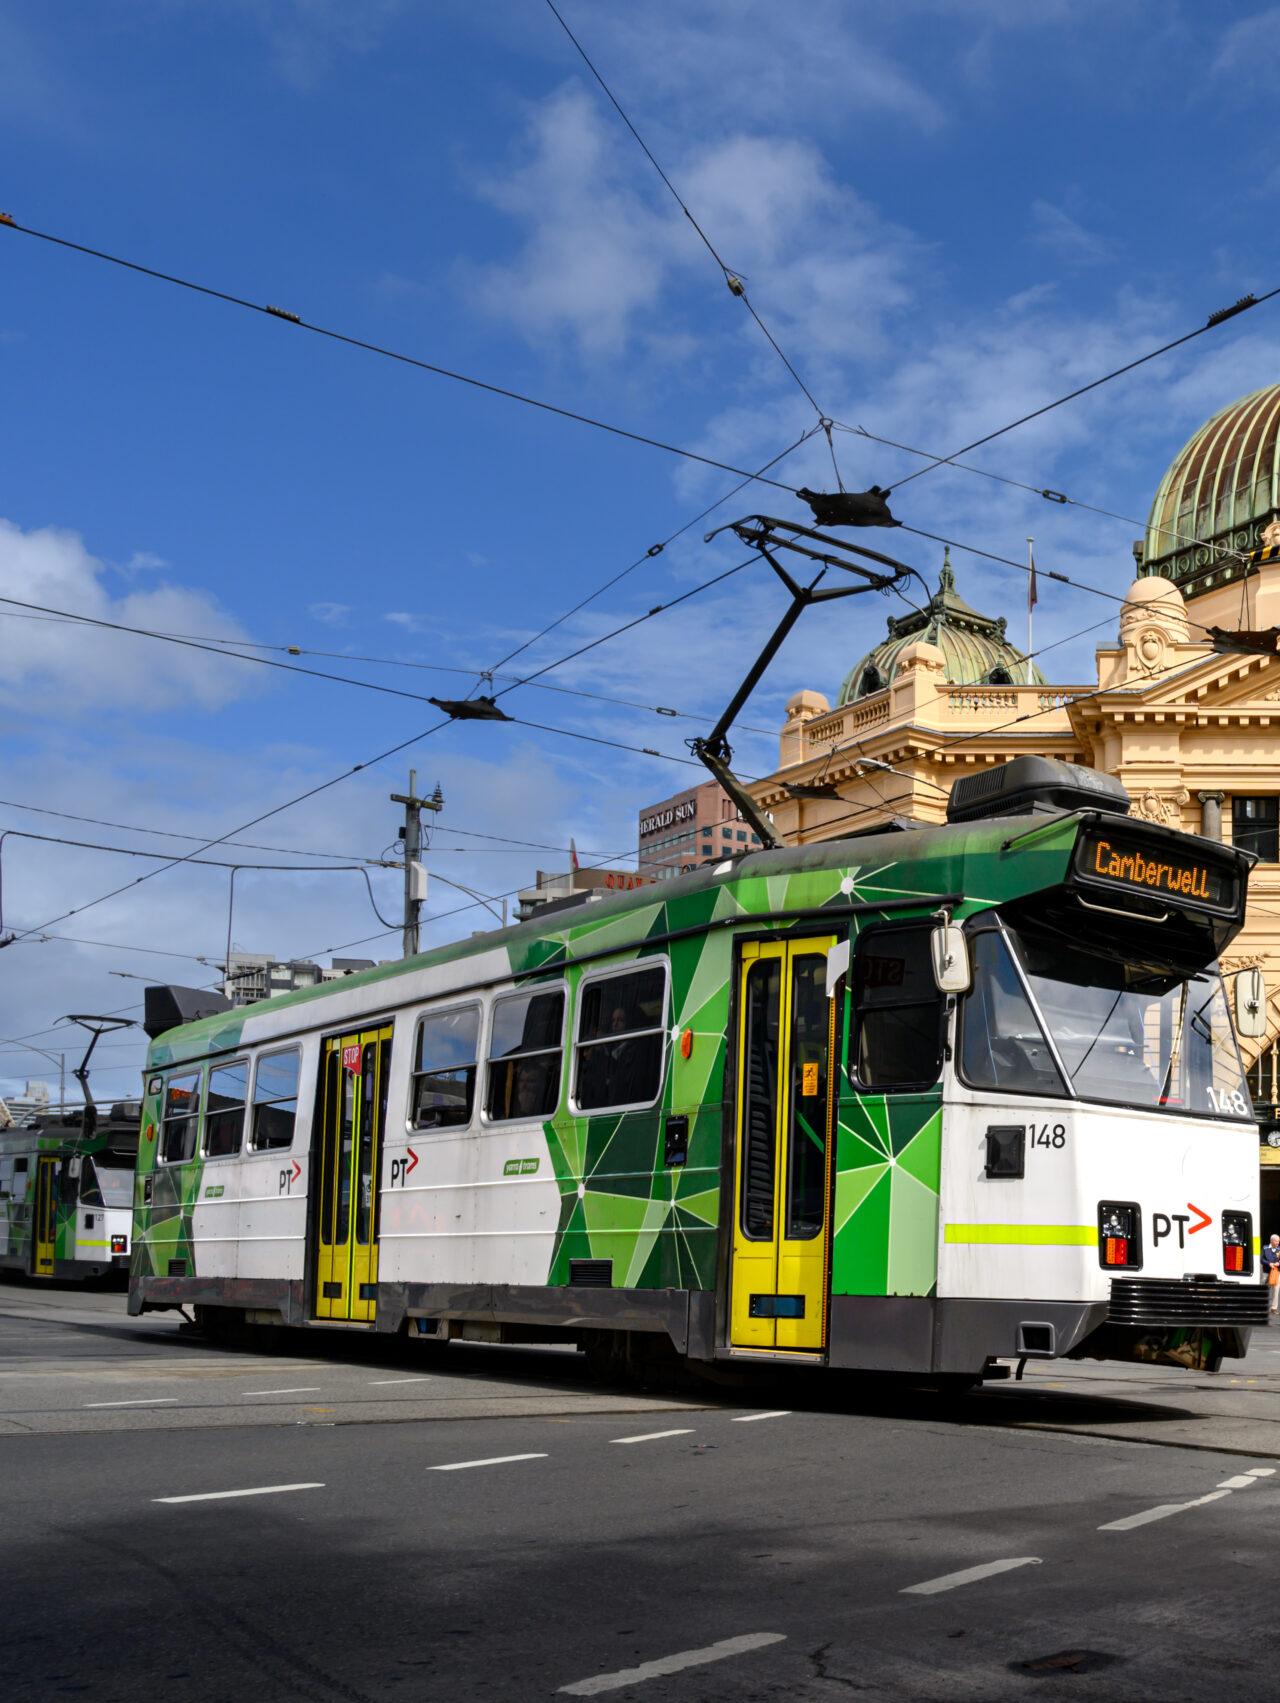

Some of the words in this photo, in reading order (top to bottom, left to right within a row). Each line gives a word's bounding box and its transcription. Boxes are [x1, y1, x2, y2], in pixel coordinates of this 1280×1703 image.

[675, 801, 695, 821] SUN
[1095, 841, 1210, 898] Camberwell
[343, 1047, 360, 1065] STOP
[1206, 1086, 1248, 1116] 148
[1029, 1124, 1066, 1149] 148
[522, 1161, 537, 1170] trams
